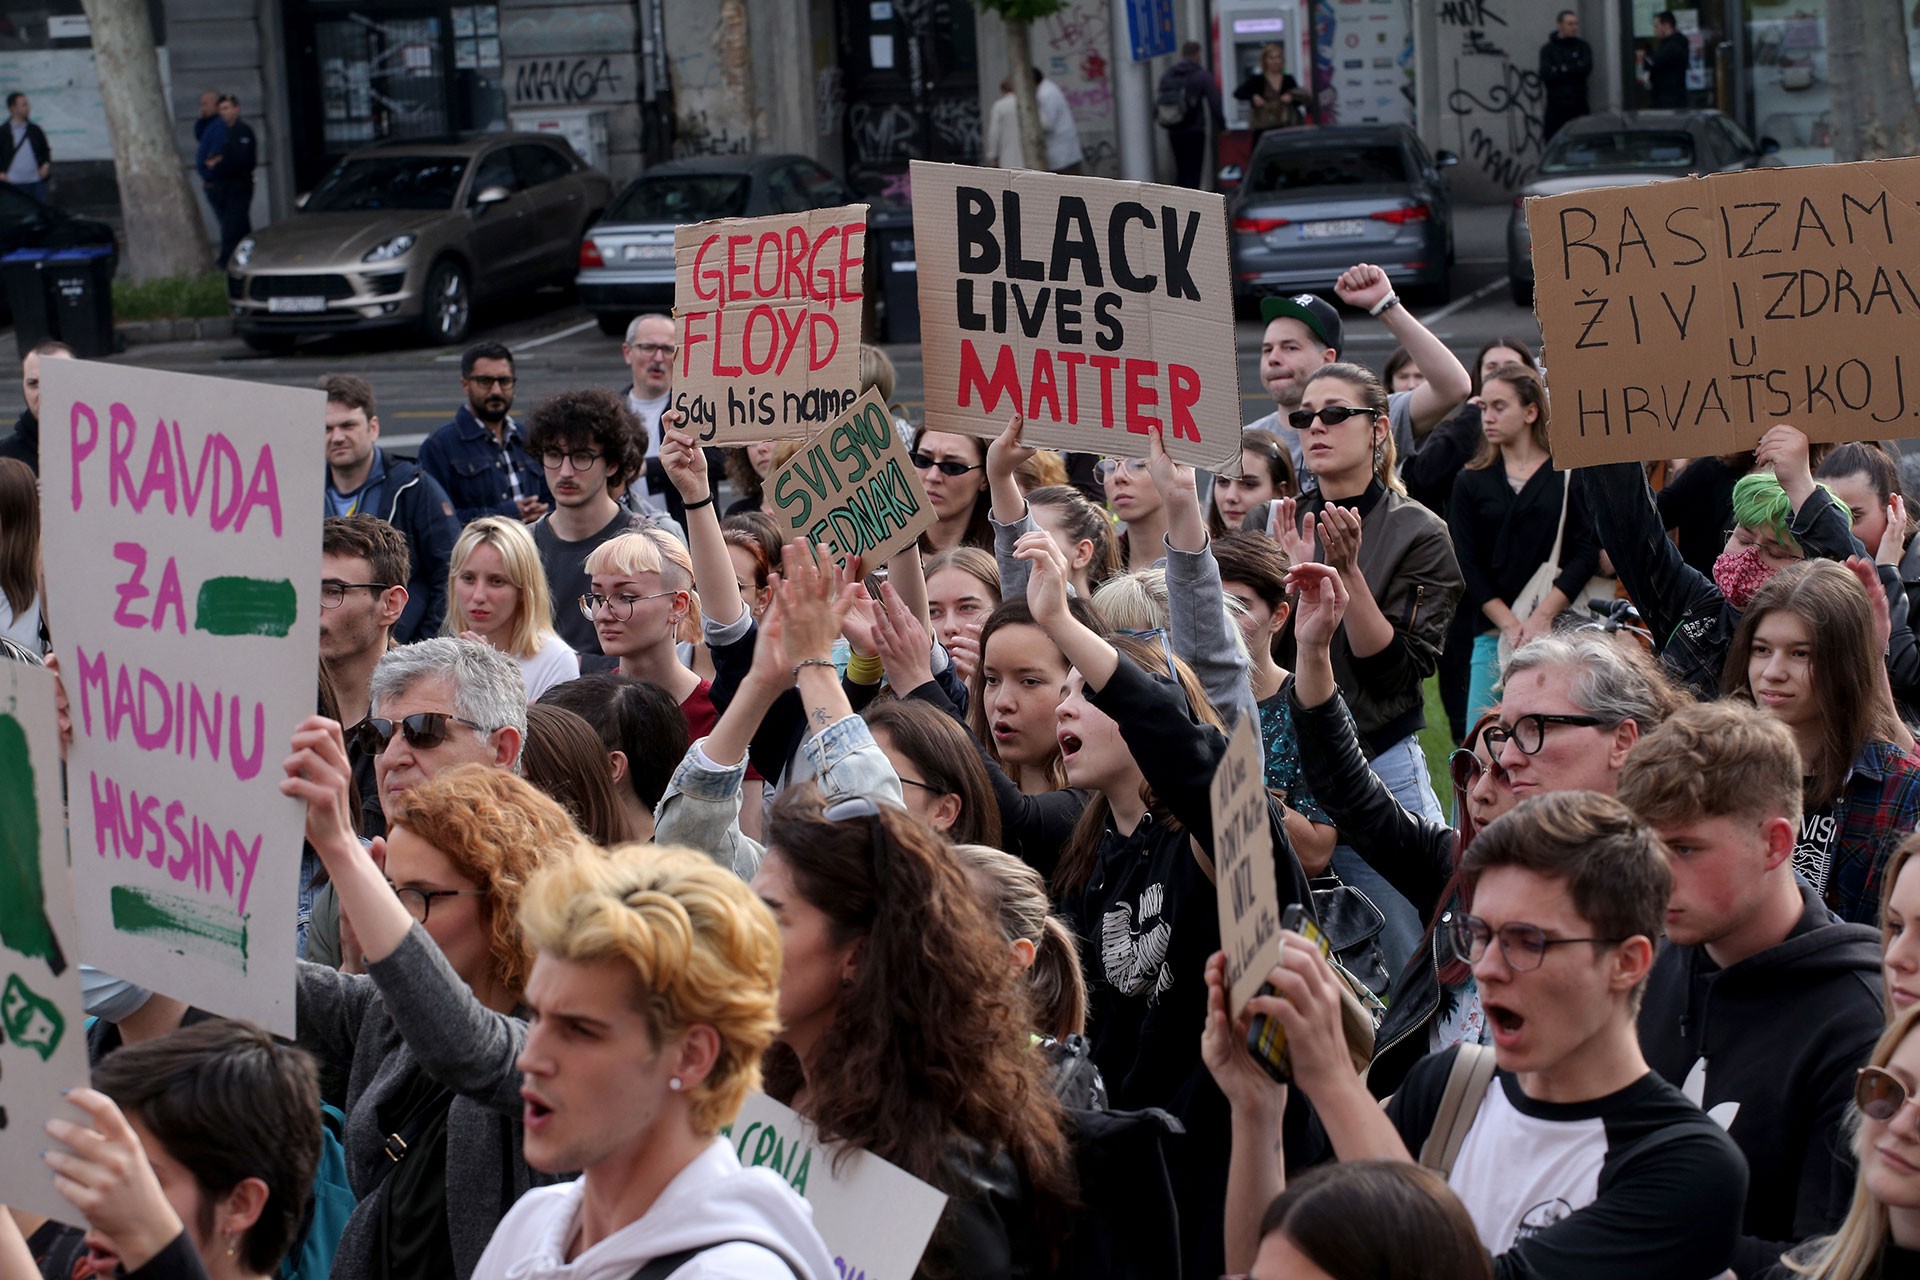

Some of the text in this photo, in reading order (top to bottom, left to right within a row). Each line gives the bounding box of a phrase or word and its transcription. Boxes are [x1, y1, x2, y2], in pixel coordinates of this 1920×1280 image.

[516, 58, 622, 103] MANGA
[693, 222, 867, 312] GEORGE
[956, 186, 1201, 301] BLACK
[1559, 191, 1893, 279] RASIZAM
[683, 304, 839, 378] FLOYD
[956, 278, 1123, 351] LIVES
[1574, 285, 1697, 349] ŽIV
[1729, 335, 1757, 367] U
[728, 386, 775, 427] his
[783, 386, 857, 424] name
[957, 339, 1201, 443] MATTER
[1577, 355, 1920, 437] HRVATSKOJ.
[70, 401, 282, 538] PRAVDA
[775, 402, 891, 529] SVI SMO
[113, 541, 187, 636] ZA
[77, 645, 265, 781] MADINU
[90, 770, 263, 916] HUSSINY
